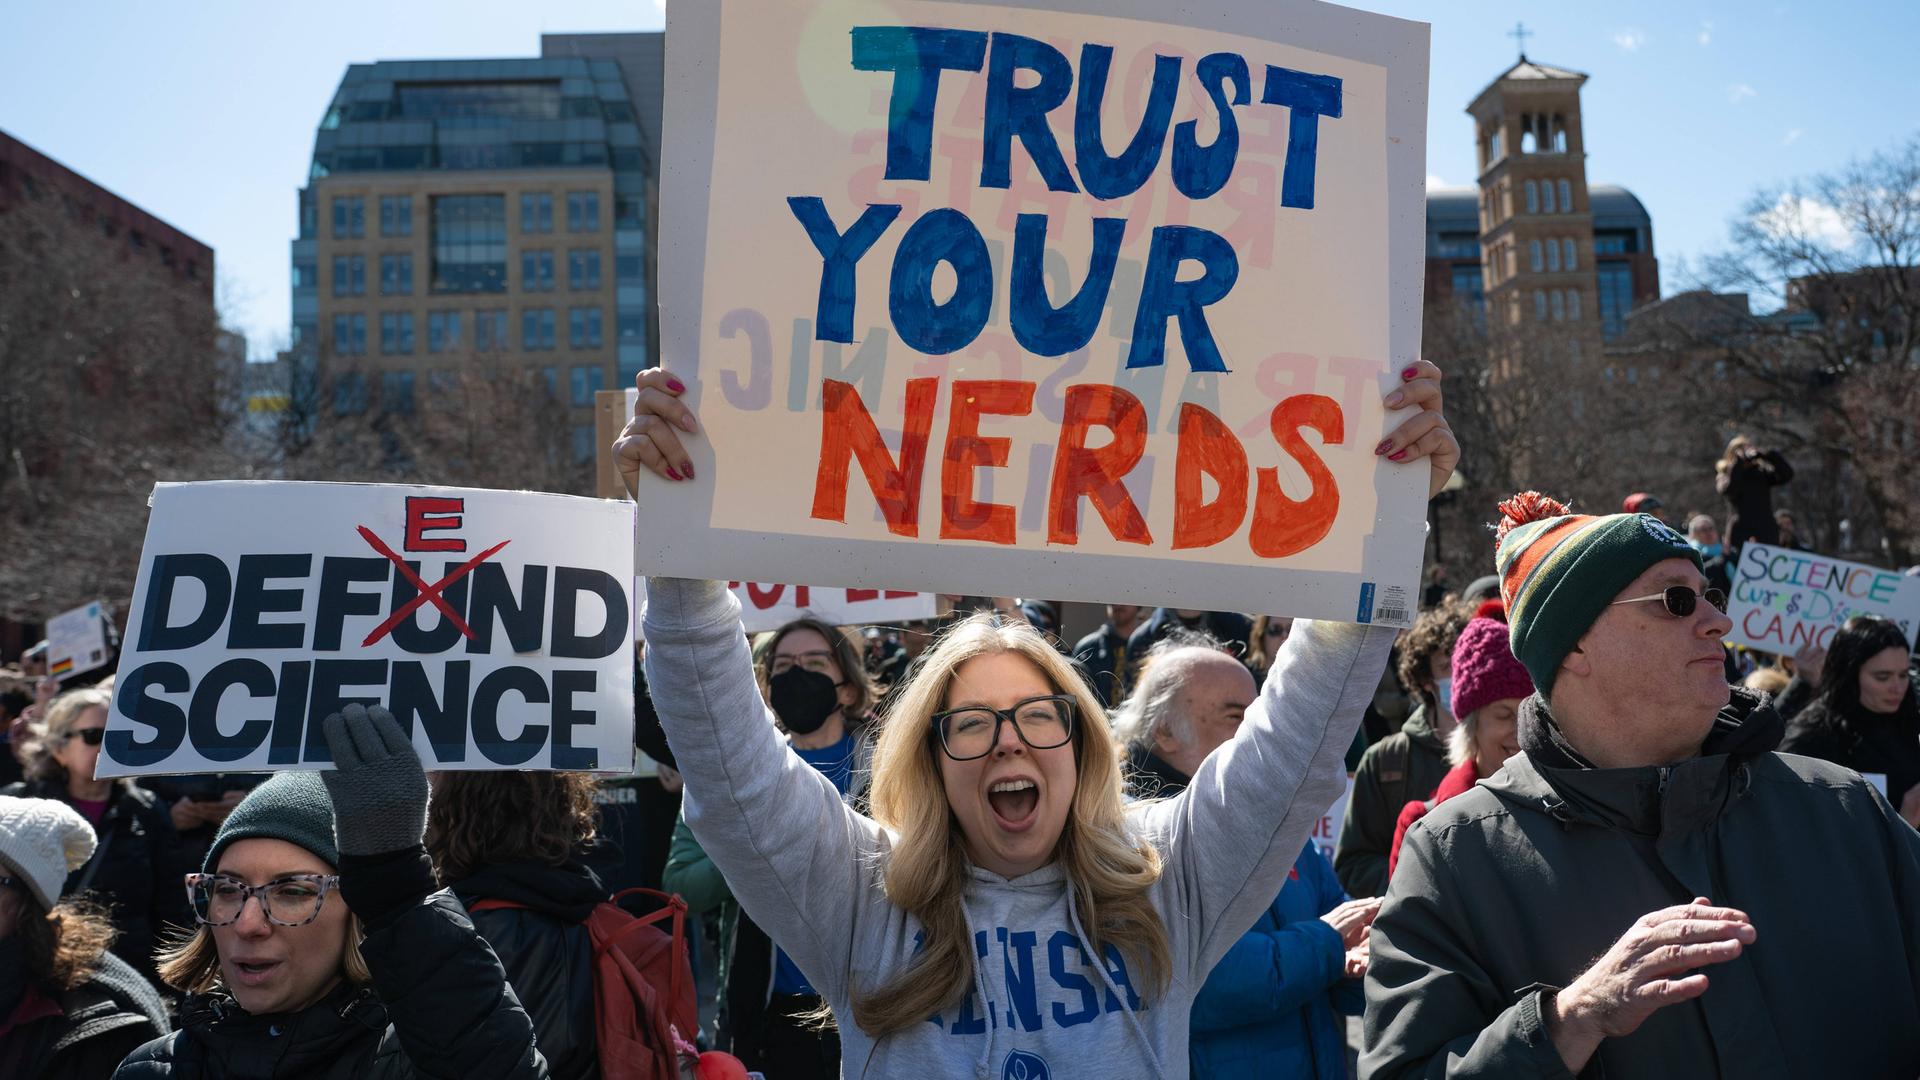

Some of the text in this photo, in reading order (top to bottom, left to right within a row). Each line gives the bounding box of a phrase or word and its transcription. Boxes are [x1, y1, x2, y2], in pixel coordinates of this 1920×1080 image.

[850, 26, 1343, 210] TRUST
[787, 196, 1240, 372] YOUR
[810, 376, 1345, 558] NERDS
[404, 496, 467, 552] E
[1741, 547, 1902, 603] SCIENCE
[136, 554, 629, 659] DEFUND
[105, 658, 598, 770] SCIENCE
